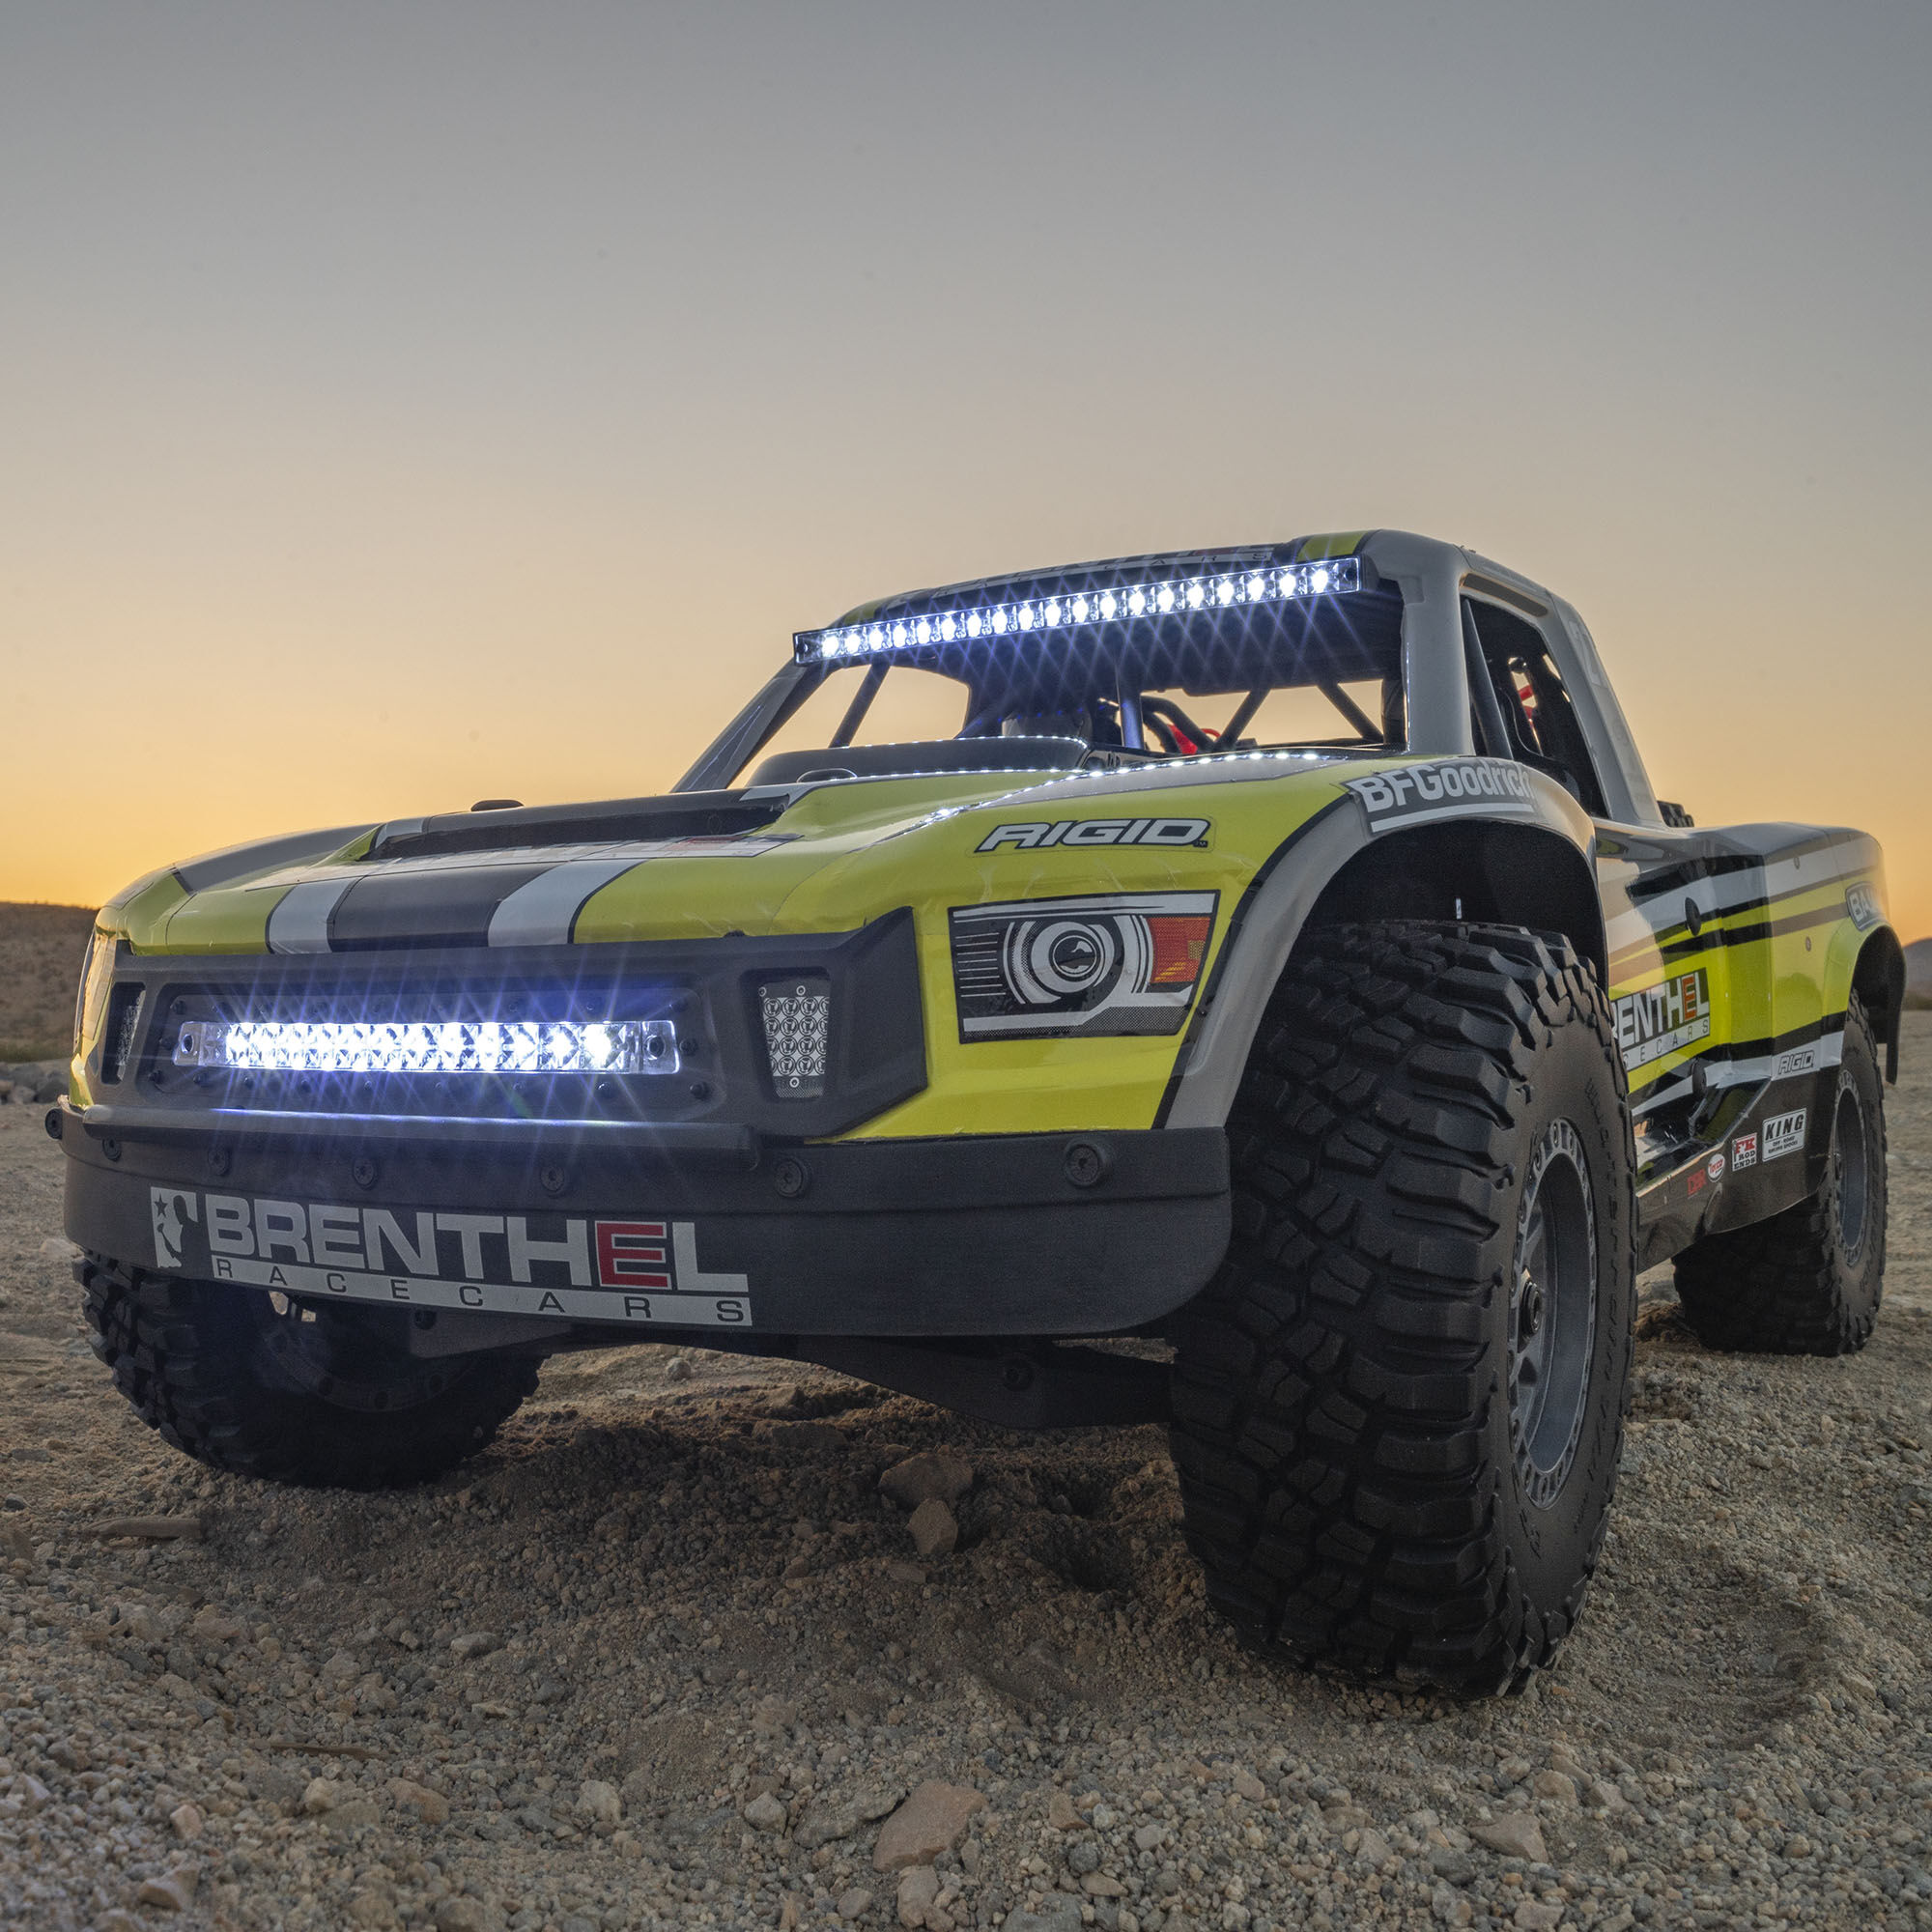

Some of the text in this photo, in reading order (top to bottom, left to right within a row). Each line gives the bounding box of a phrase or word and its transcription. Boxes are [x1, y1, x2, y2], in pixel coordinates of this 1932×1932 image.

[1346, 758, 1534, 813] BFGoodrich
[975, 818, 1210, 853] RIGID
[1778, 1050, 1815, 1075] RIGID
[1765, 1114, 1804, 1141] KING
[1734, 1137, 1755, 1154] FK
[206, 1193, 750, 1293] BRENTHEL
[216, 1258, 744, 1322] RACECARS
